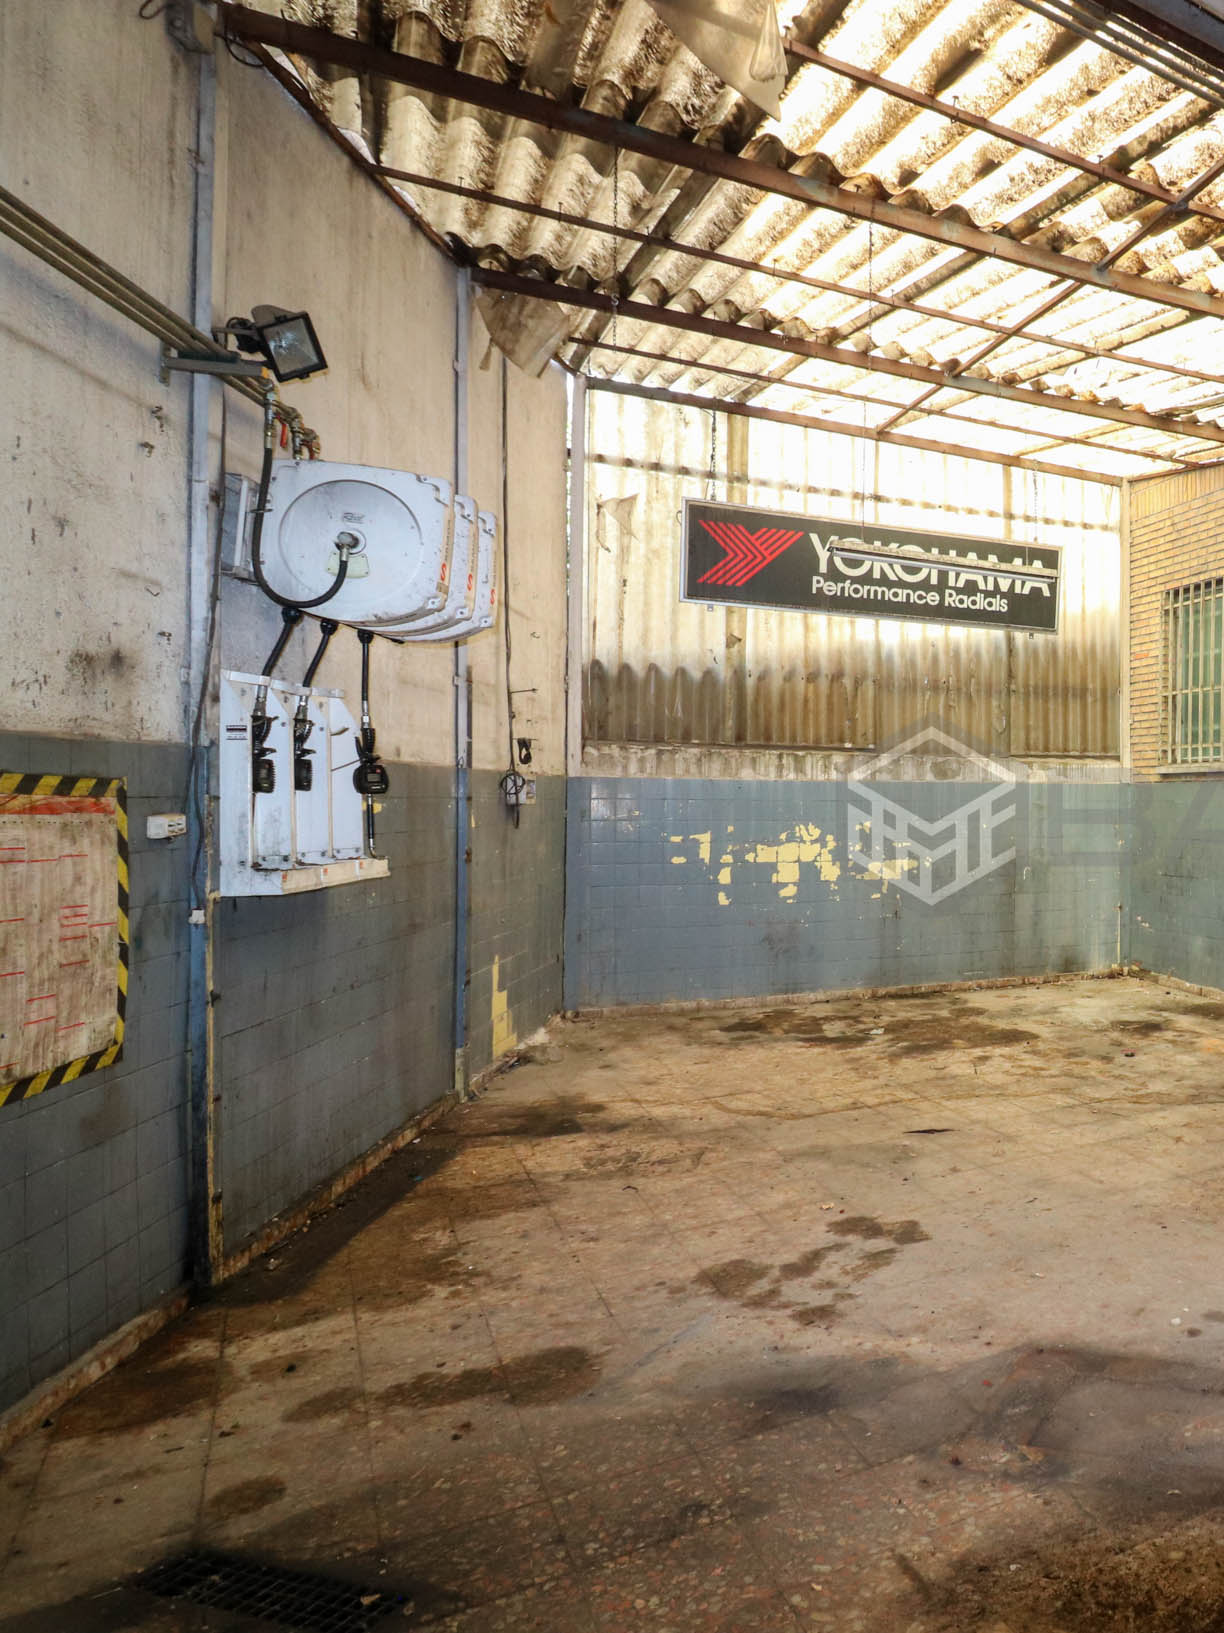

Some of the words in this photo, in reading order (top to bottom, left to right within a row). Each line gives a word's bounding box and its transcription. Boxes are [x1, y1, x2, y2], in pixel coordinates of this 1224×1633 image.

[808, 533, 1050, 596] YOKOHAMA
[811, 575, 940, 606] Performance
[944, 588, 1009, 613] Radials
